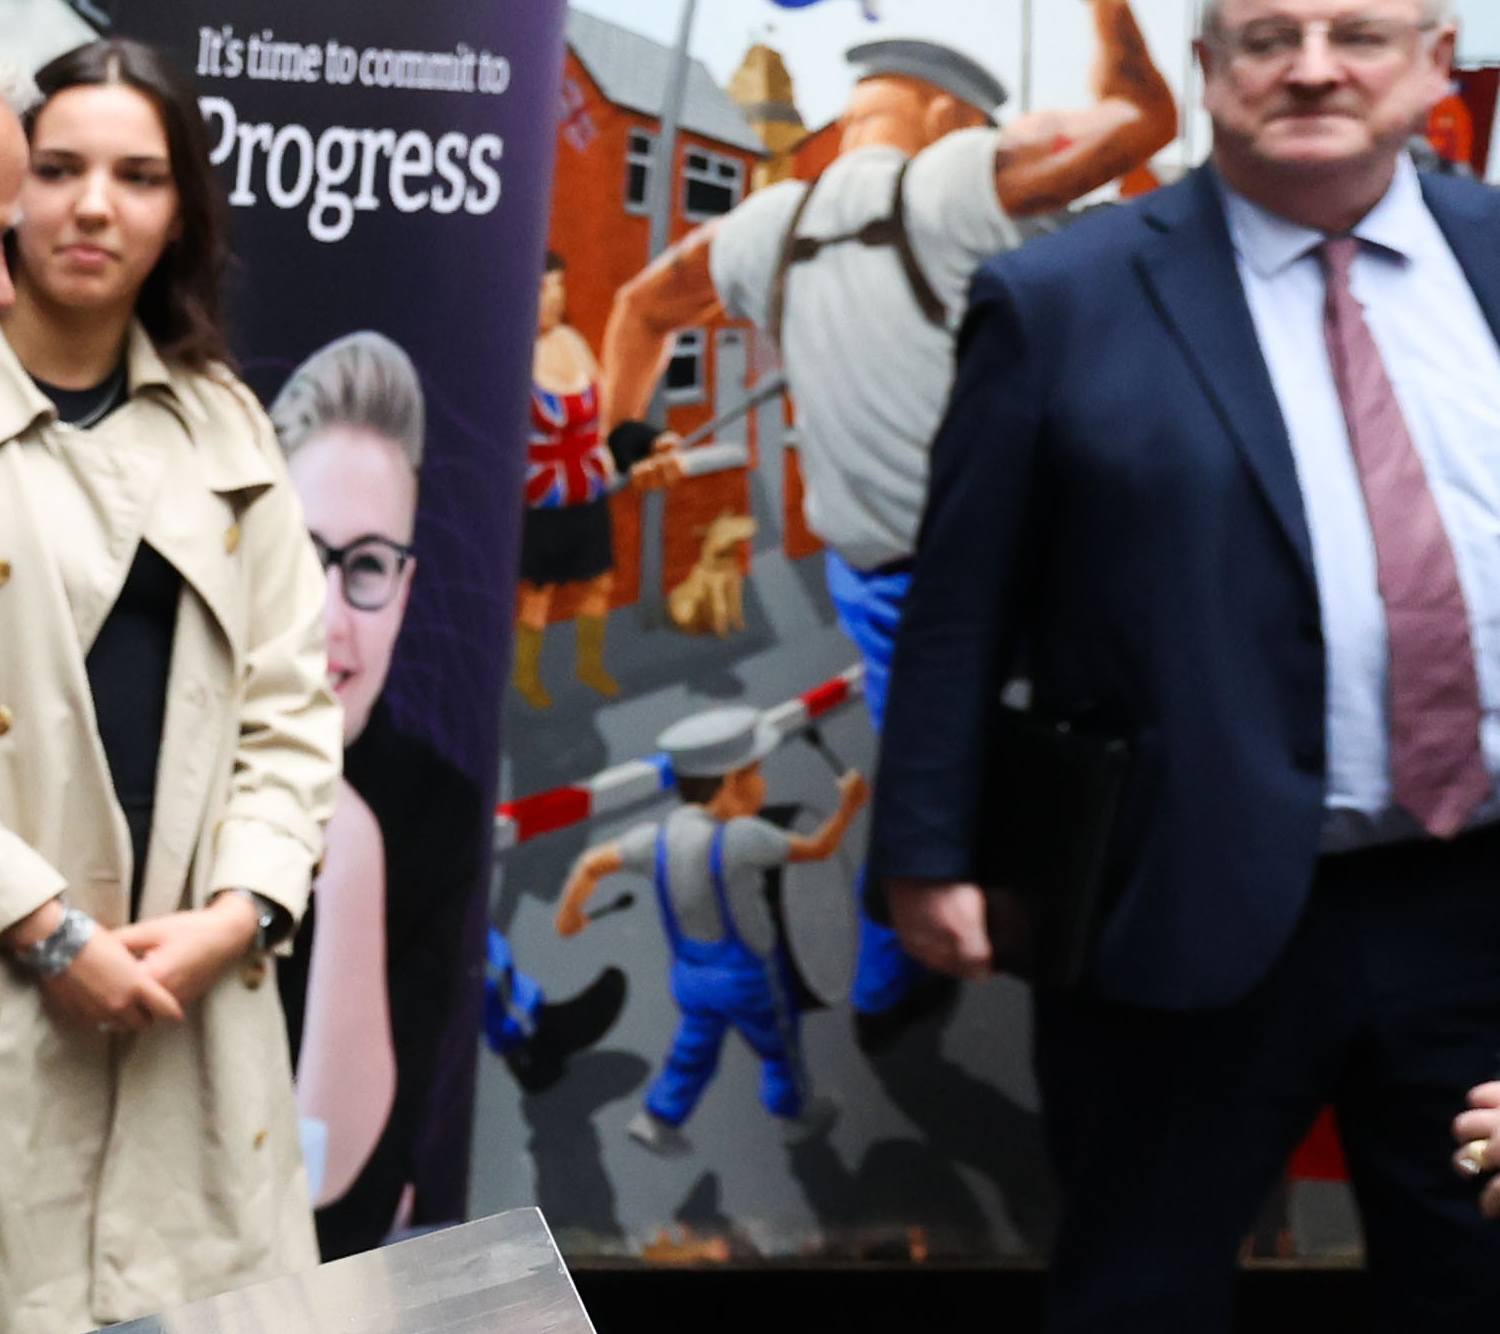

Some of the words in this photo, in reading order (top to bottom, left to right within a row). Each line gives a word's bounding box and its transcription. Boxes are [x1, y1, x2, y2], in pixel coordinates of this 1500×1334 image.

[197, 23, 245, 78] It's
[247, 28, 323, 83] time
[324, 38, 357, 86] to
[359, 41, 476, 93] commit
[477, 48, 511, 95] to
